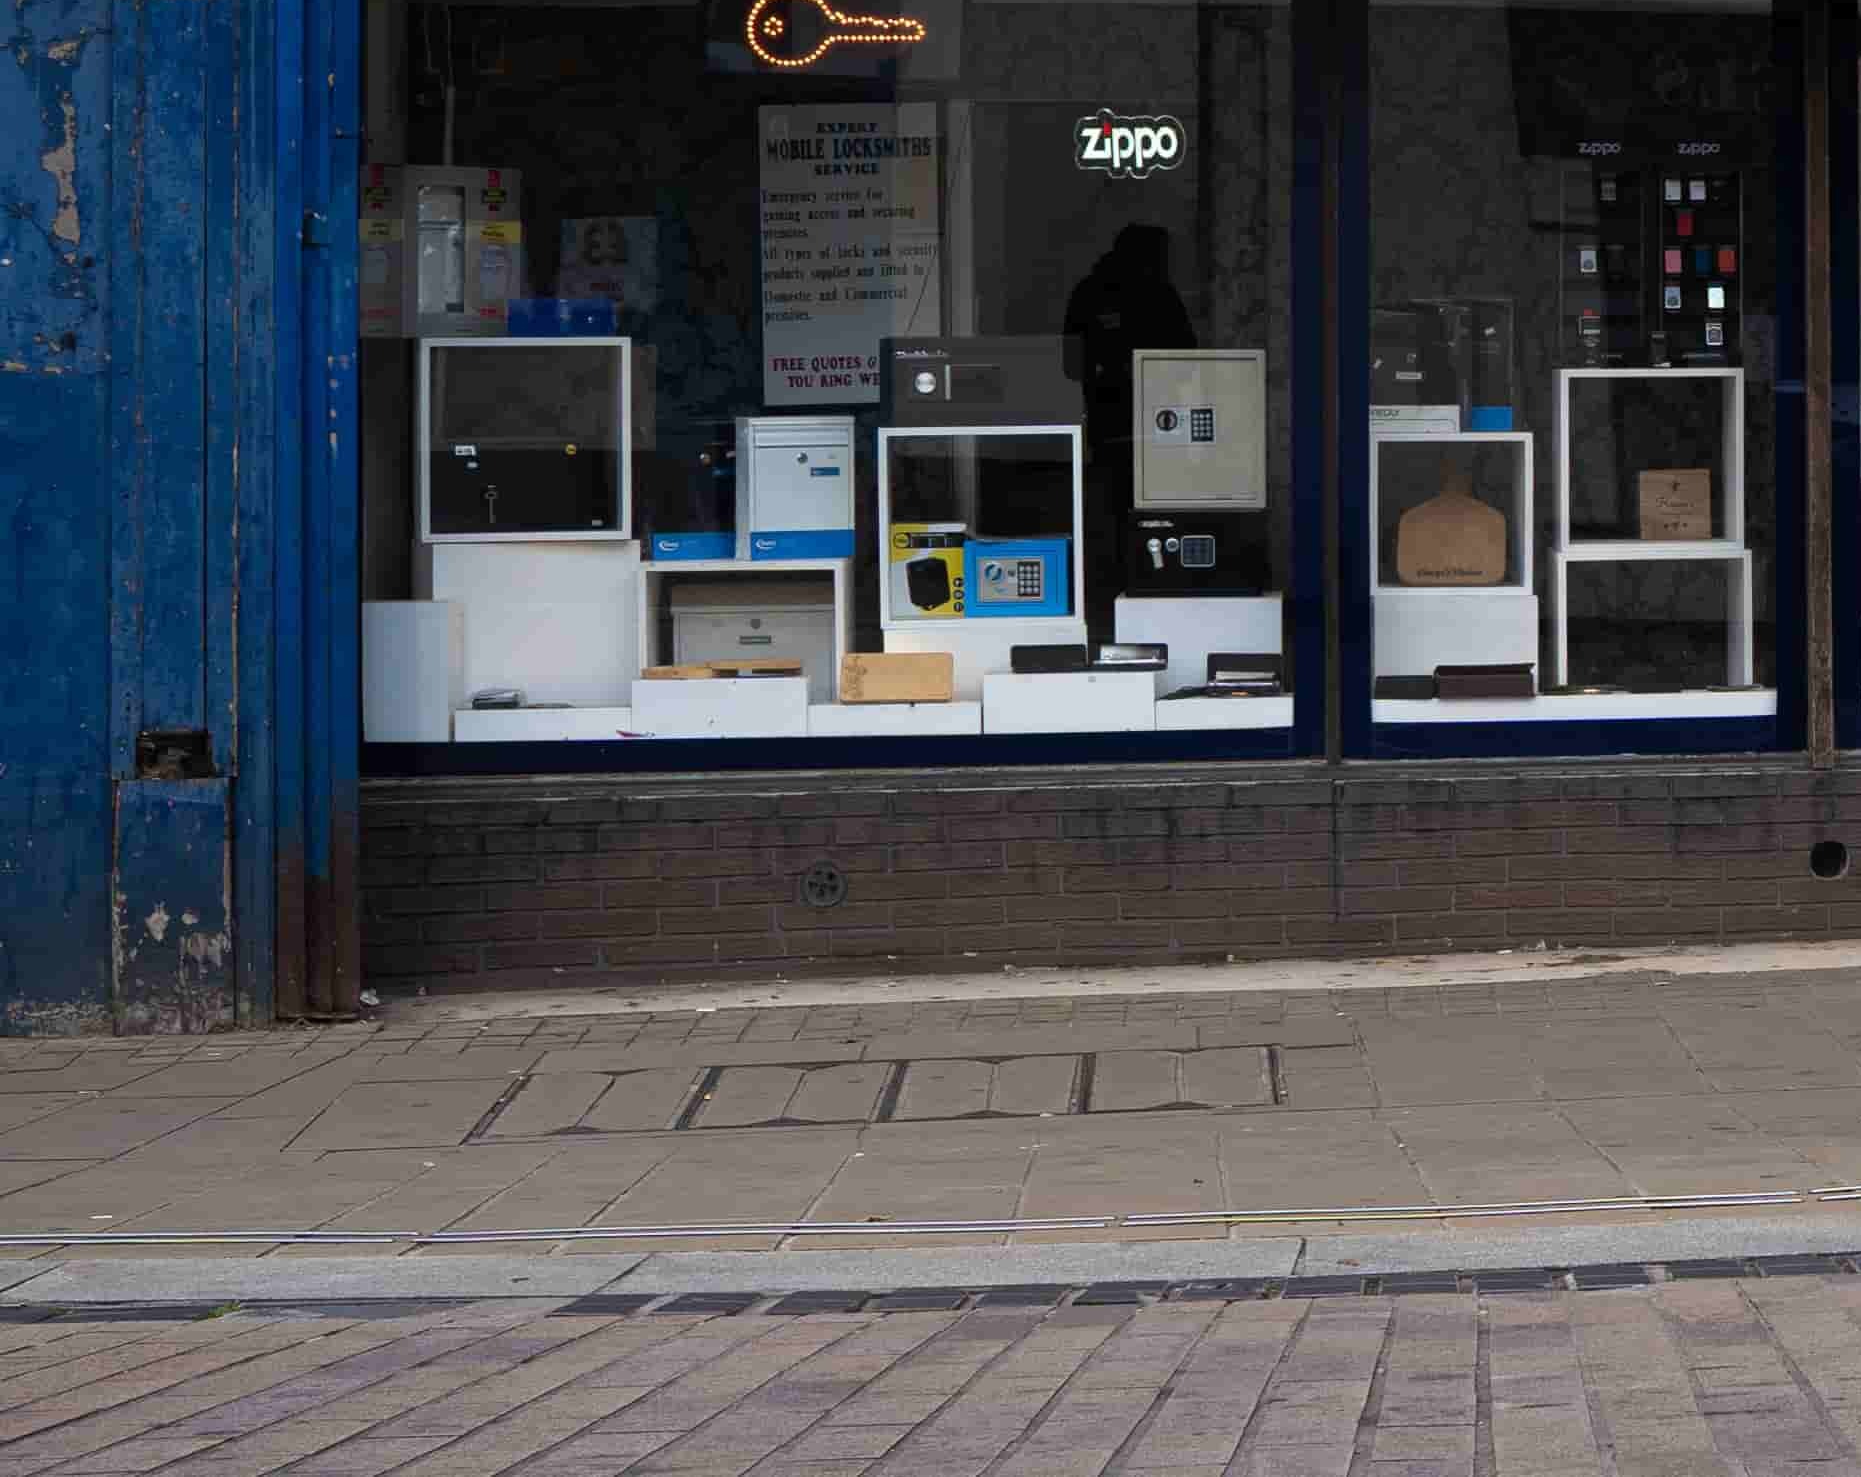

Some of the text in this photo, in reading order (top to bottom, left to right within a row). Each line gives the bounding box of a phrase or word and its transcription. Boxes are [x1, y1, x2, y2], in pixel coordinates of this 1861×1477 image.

[766, 137, 932, 159] MOBILE LOCKSMITHS
[1081, 118, 1178, 169] zippo
[814, 163, 880, 176] SERVICE
[772, 358, 806, 372] FREE
[811, 356, 860, 371] QUOTES
[820, 374, 852, 388] RING
